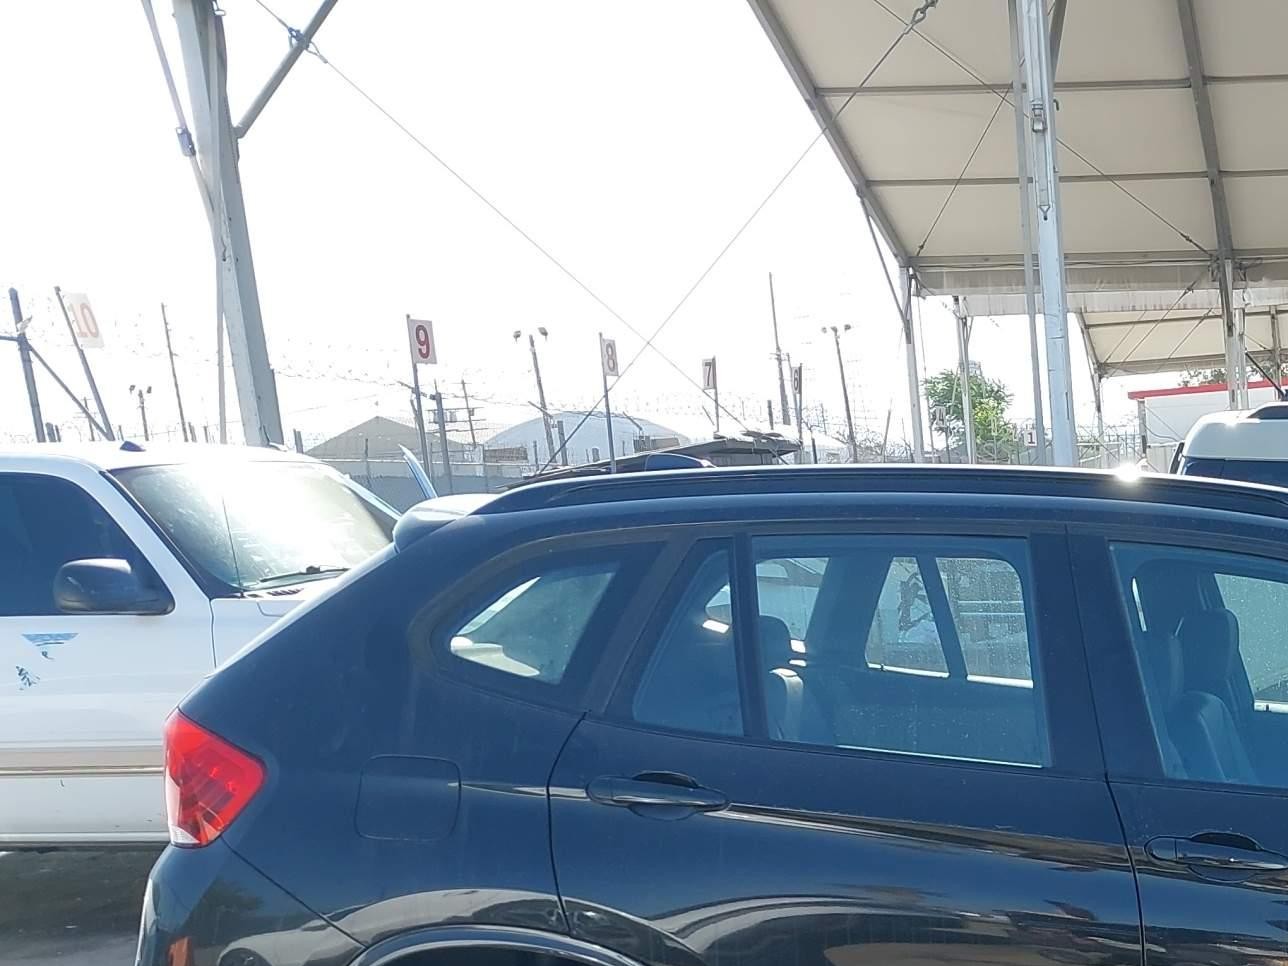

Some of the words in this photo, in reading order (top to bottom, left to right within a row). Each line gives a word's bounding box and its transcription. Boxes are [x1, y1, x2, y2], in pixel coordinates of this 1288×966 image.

[66, 302, 99, 338] 10
[415, 324, 430, 359] 9
[605, 342, 616, 372] 8
[704, 361, 712, 387] 7
[793, 369, 799, 391] 6
[1027, 432, 1036, 444] 1
